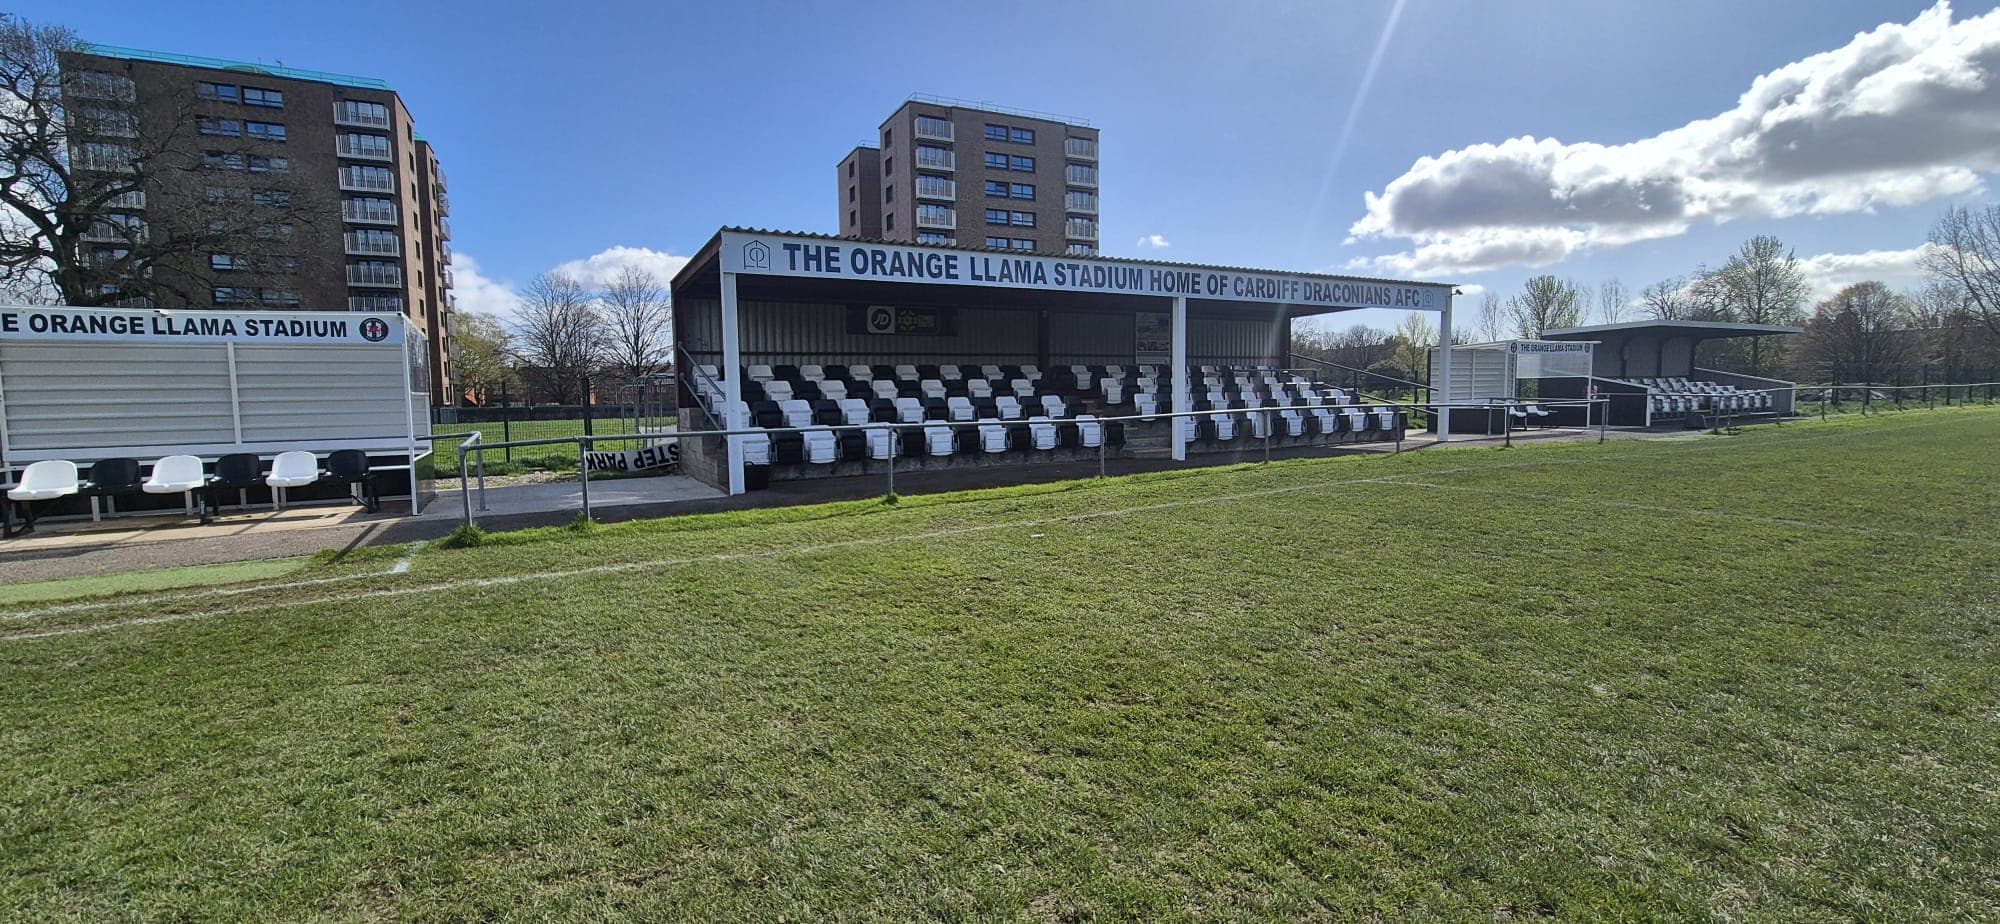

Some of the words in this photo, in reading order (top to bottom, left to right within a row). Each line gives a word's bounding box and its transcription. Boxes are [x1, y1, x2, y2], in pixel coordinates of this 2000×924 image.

[783, 242, 841, 273] THE
[850, 247, 959, 280] ORANGE
[969, 256, 1048, 285] LLAMA
[1054, 262, 1144, 291] STADIUM
[1150, 269, 1201, 294] HOME
[1206, 273, 1228, 296] OF
[1233, 276, 1299, 300] CARDIFF
[1303, 281, 1391, 306] DRACONIANS
[1395, 286, 1420, 307] AFC
[28, 313, 146, 335] ORANGE
[151, 316, 238, 337] LLAMA
[244, 318, 348, 338] STADIUM
[1521, 343, 1530, 352] THE
[1531, 344, 1549, 353] ORANGE
[1564, 344, 1583, 352] STADIUM
[585, 452, 629, 471] PARK
[633, 443, 680, 470] STEP
